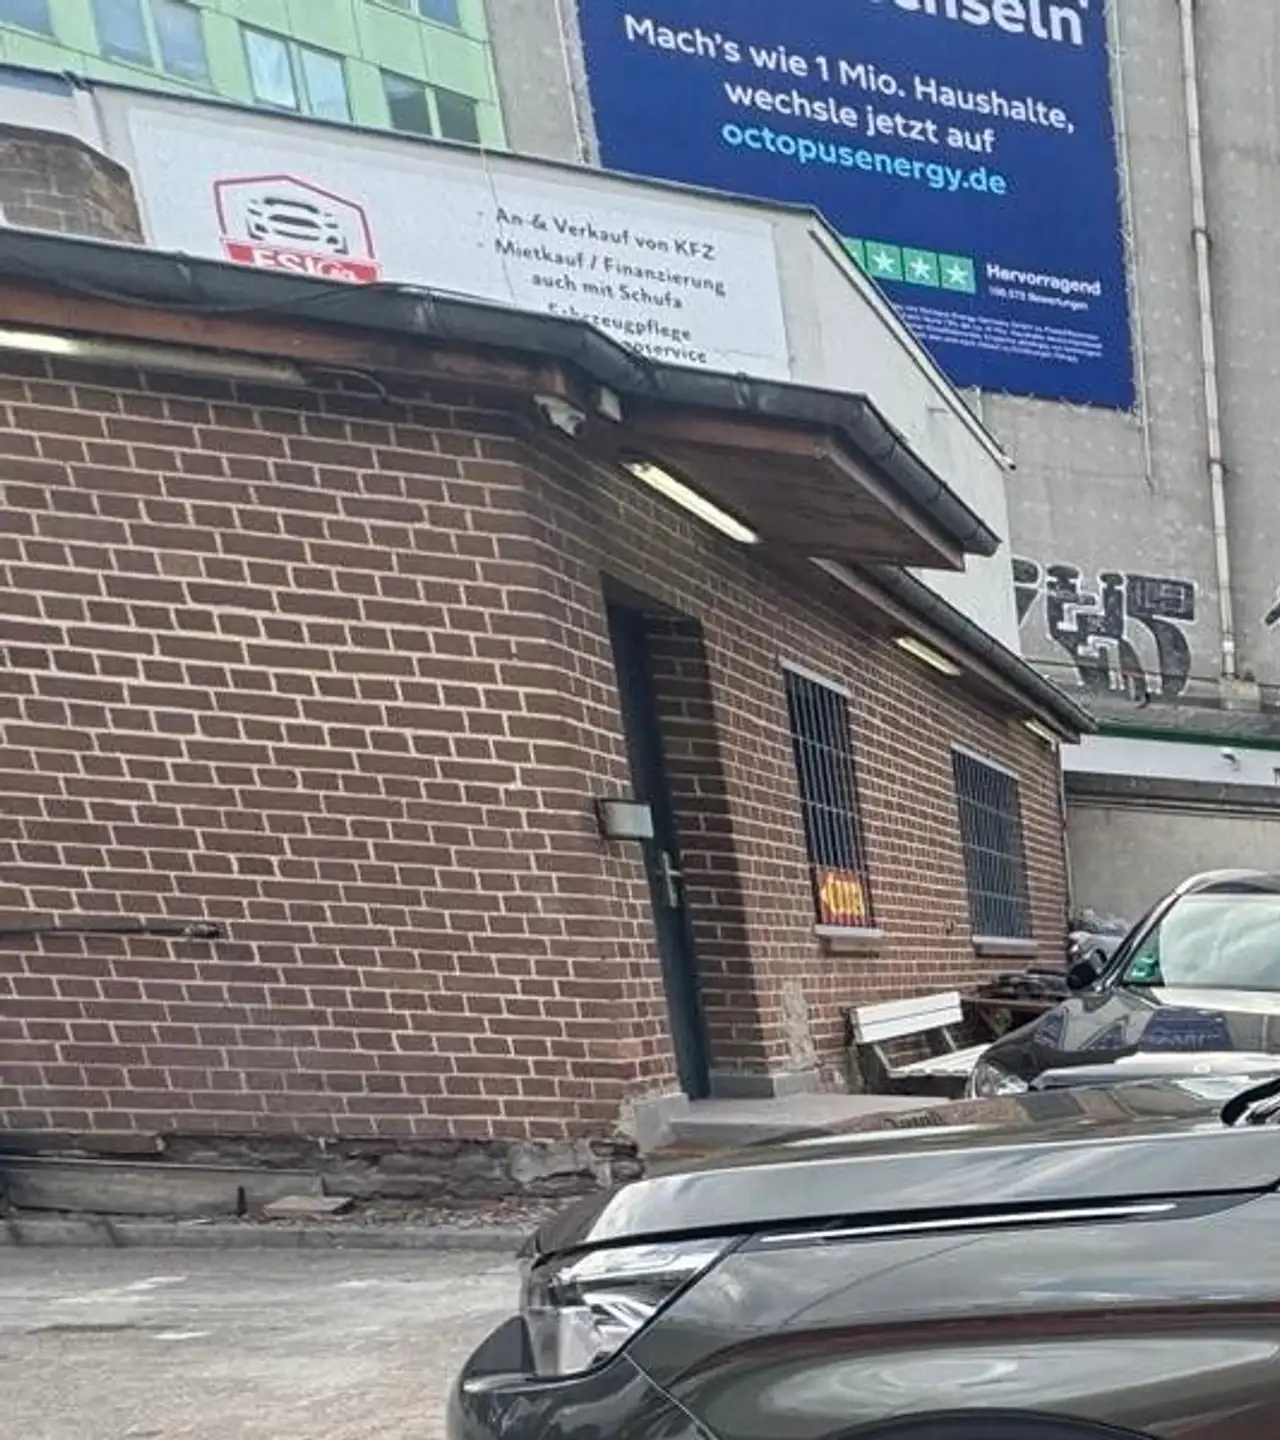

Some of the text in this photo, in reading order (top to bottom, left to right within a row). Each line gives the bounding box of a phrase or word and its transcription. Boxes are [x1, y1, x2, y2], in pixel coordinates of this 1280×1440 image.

[624, 14, 1075, 134] Mach's wie 1 Mio. Haushalte,
[724, 82, 997, 153] wechsle jetzt auf
[722, 123, 1007, 195] octopusenergy.de
[494, 238, 584, 269] Mietkauf
[603, 256, 727, 297] Finanzierung
[552, 216, 630, 247] Verkauf
[635, 234, 669, 252] von
[674, 238, 716, 261] KFZ
[531, 273, 683, 310] auch mit Schufa
